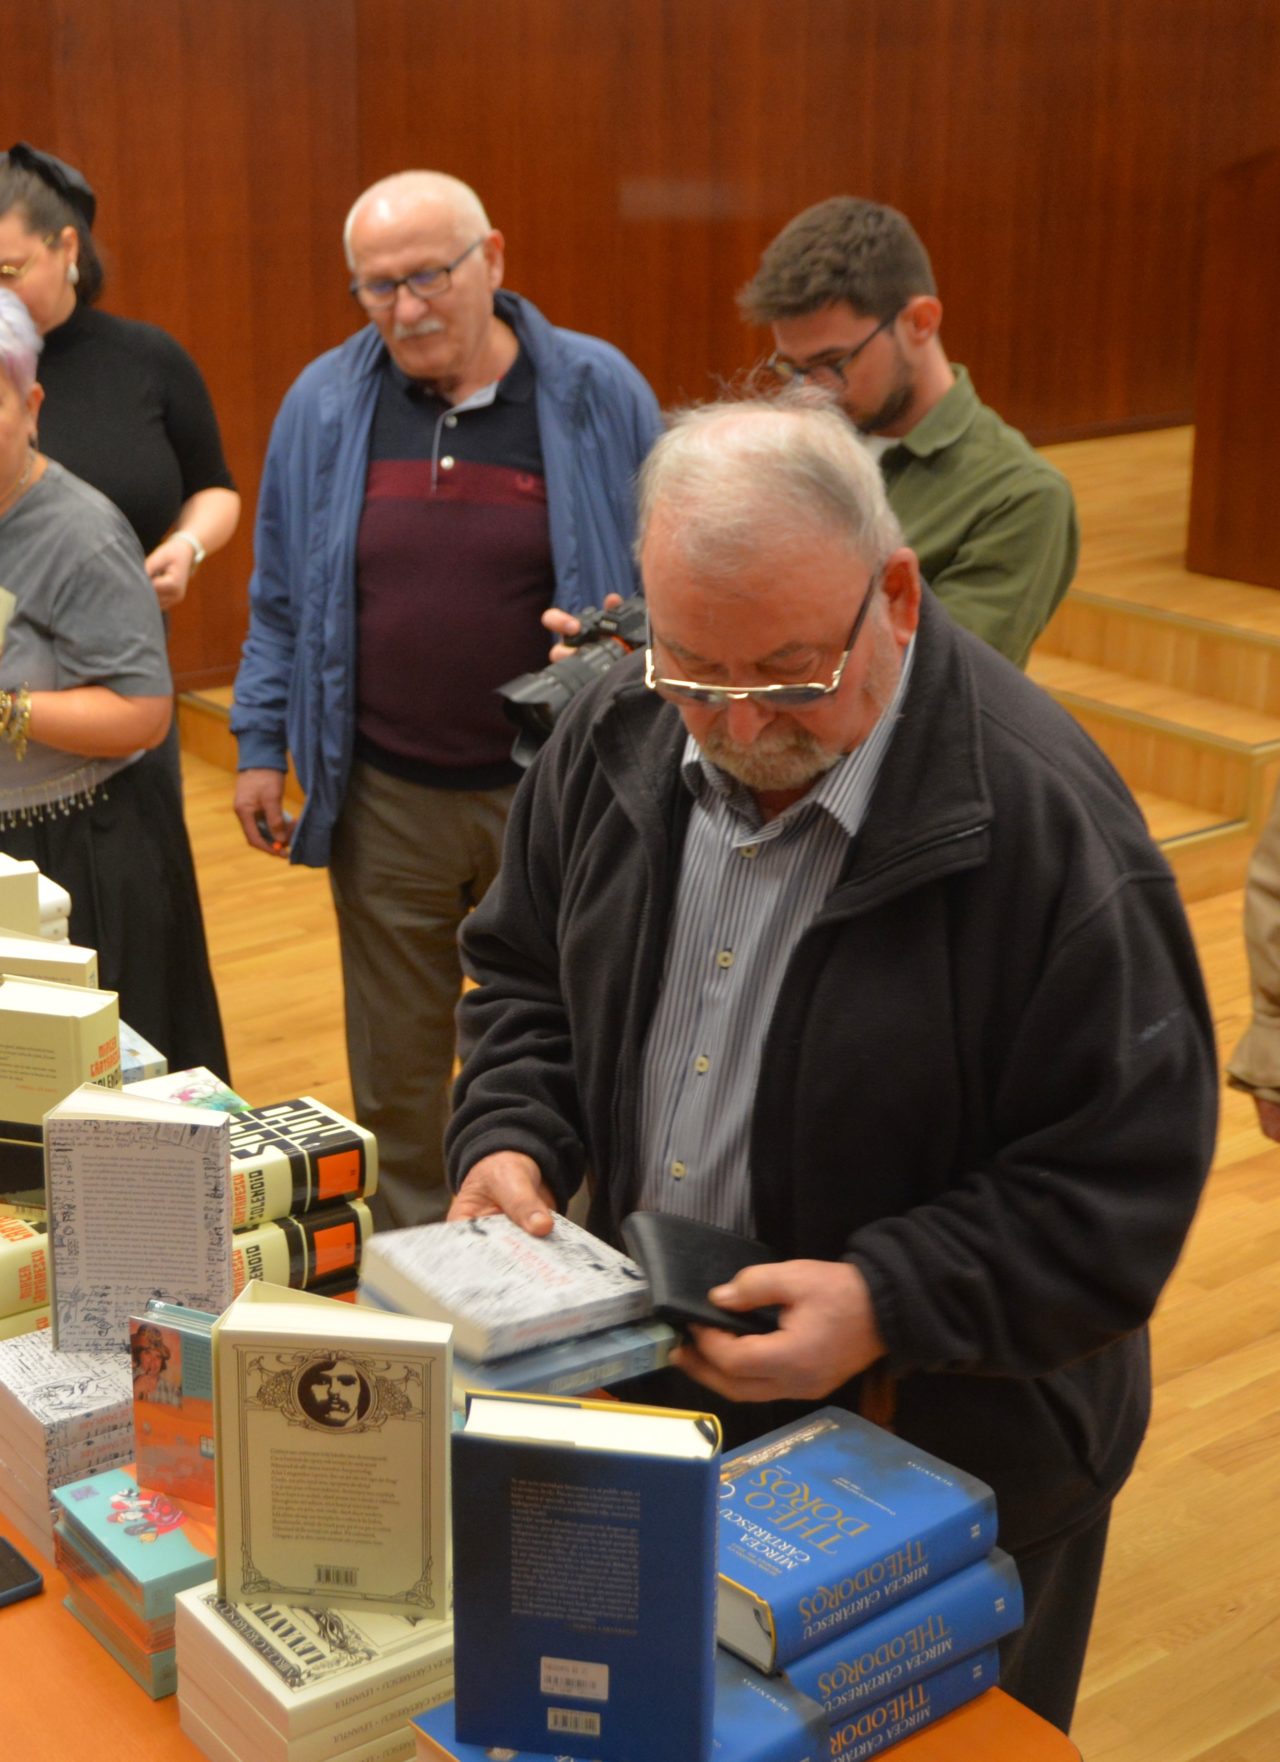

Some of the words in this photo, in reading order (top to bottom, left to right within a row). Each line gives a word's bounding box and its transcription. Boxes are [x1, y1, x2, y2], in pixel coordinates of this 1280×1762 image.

[745, 1492, 843, 1556] THEO
[749, 1469, 871, 1537] DOROS
[740, 1533, 798, 1570] MIRCEA
[799, 1540, 928, 1623] THEODOROS
[884, 1563, 929, 1596] MIRCEA
[818, 1615, 951, 1699] THEODOROS
[906, 1638, 953, 1671] MIRCEA
[830, 1683, 931, 1756] THEODOR
[886, 1705, 931, 1739] MIRCEA
